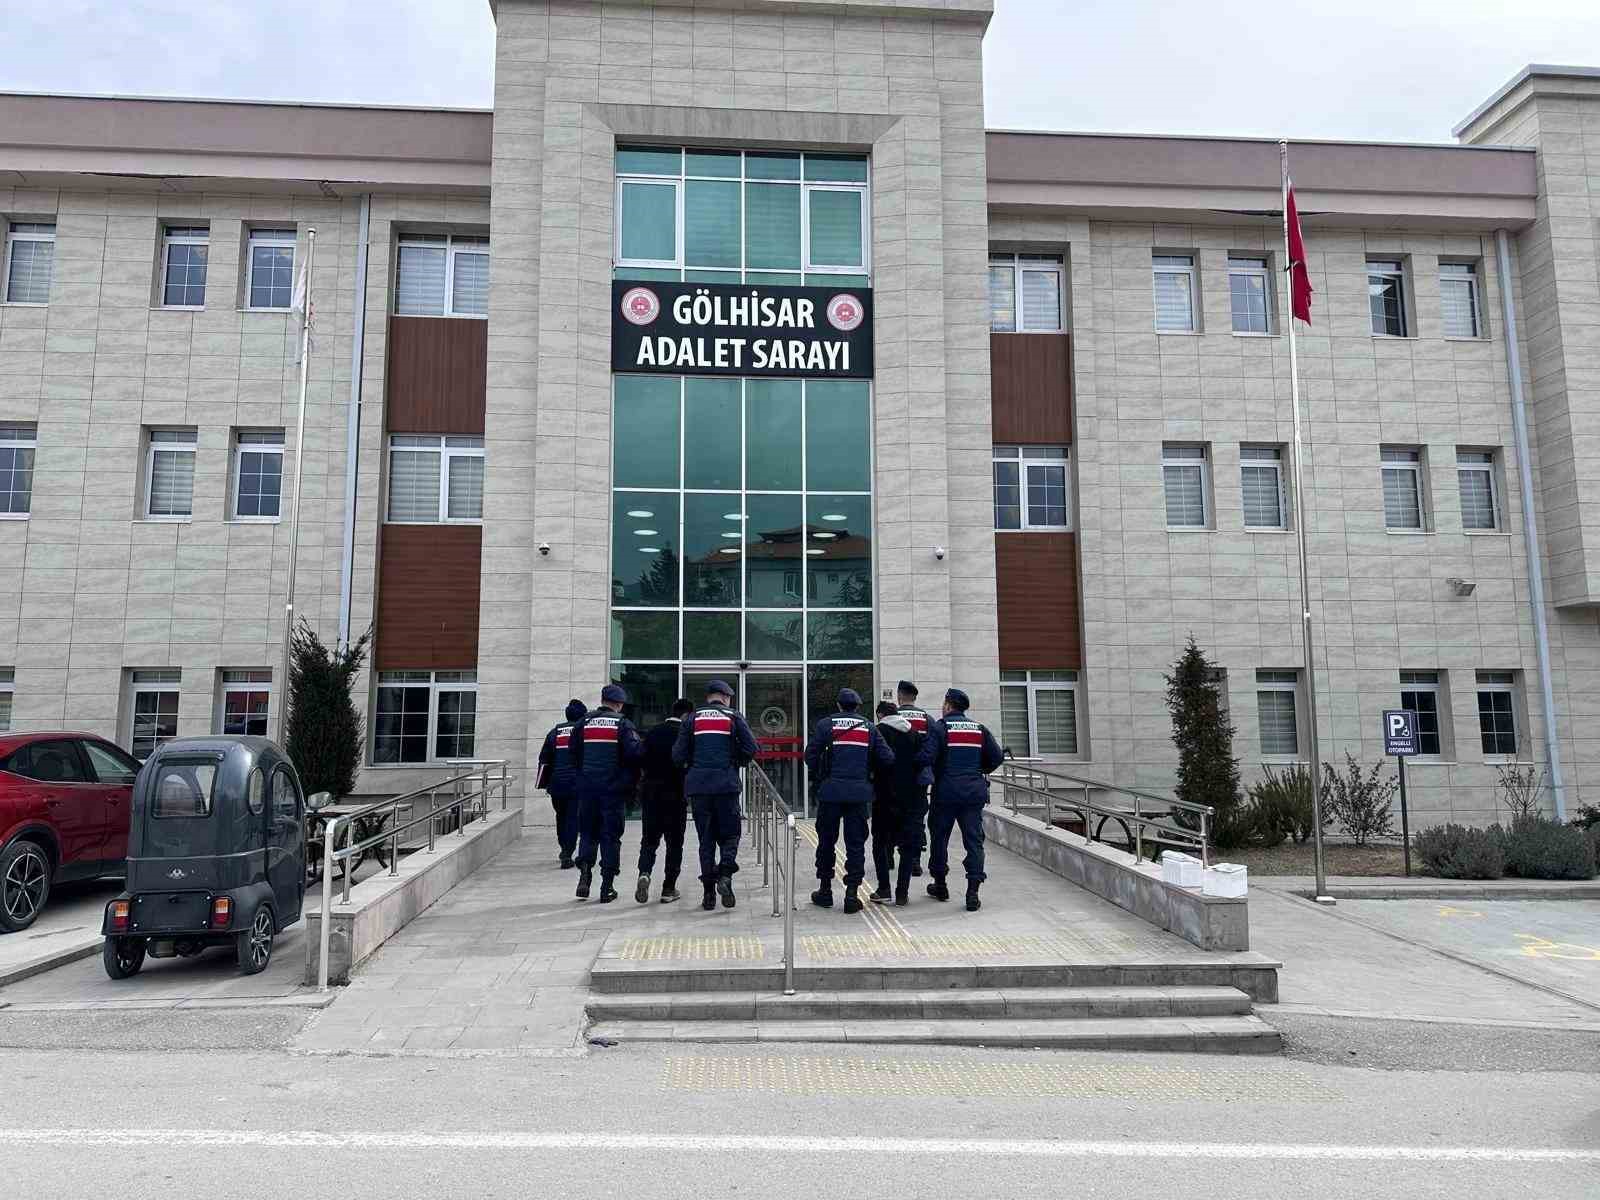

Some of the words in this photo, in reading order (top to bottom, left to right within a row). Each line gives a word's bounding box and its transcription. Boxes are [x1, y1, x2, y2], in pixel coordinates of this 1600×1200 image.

[673, 289, 815, 328] GÖLHİSAR
[636, 336, 746, 368] ADALET
[752, 339, 850, 370] SARAYI
[1390, 715, 1404, 736] P
